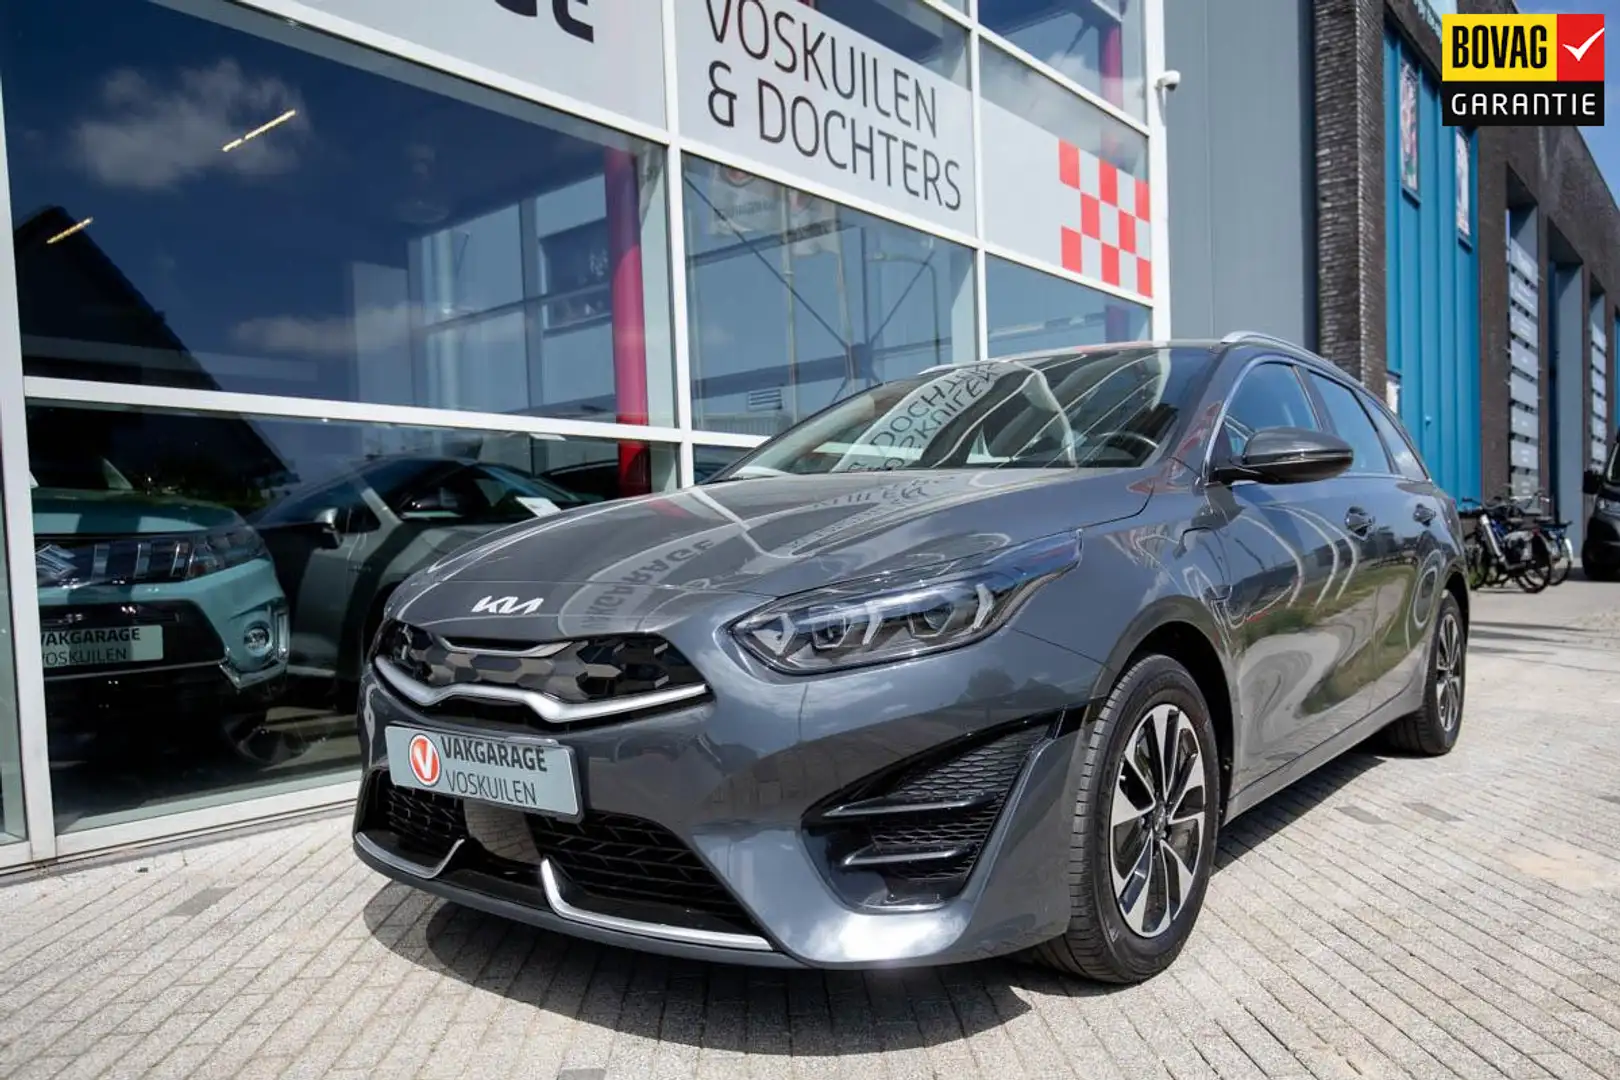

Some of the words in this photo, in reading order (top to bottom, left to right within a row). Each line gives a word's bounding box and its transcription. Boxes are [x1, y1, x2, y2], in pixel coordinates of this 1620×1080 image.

[706, 0, 937, 138] VOSKUILEN
[708, 60, 737, 127] &
[758, 79, 962, 211] DOCHTERS
[471, 595, 544, 615] KIA
[441, 736, 548, 772] VAKGARAGE
[446, 769, 537, 805] VOSKUILEN
